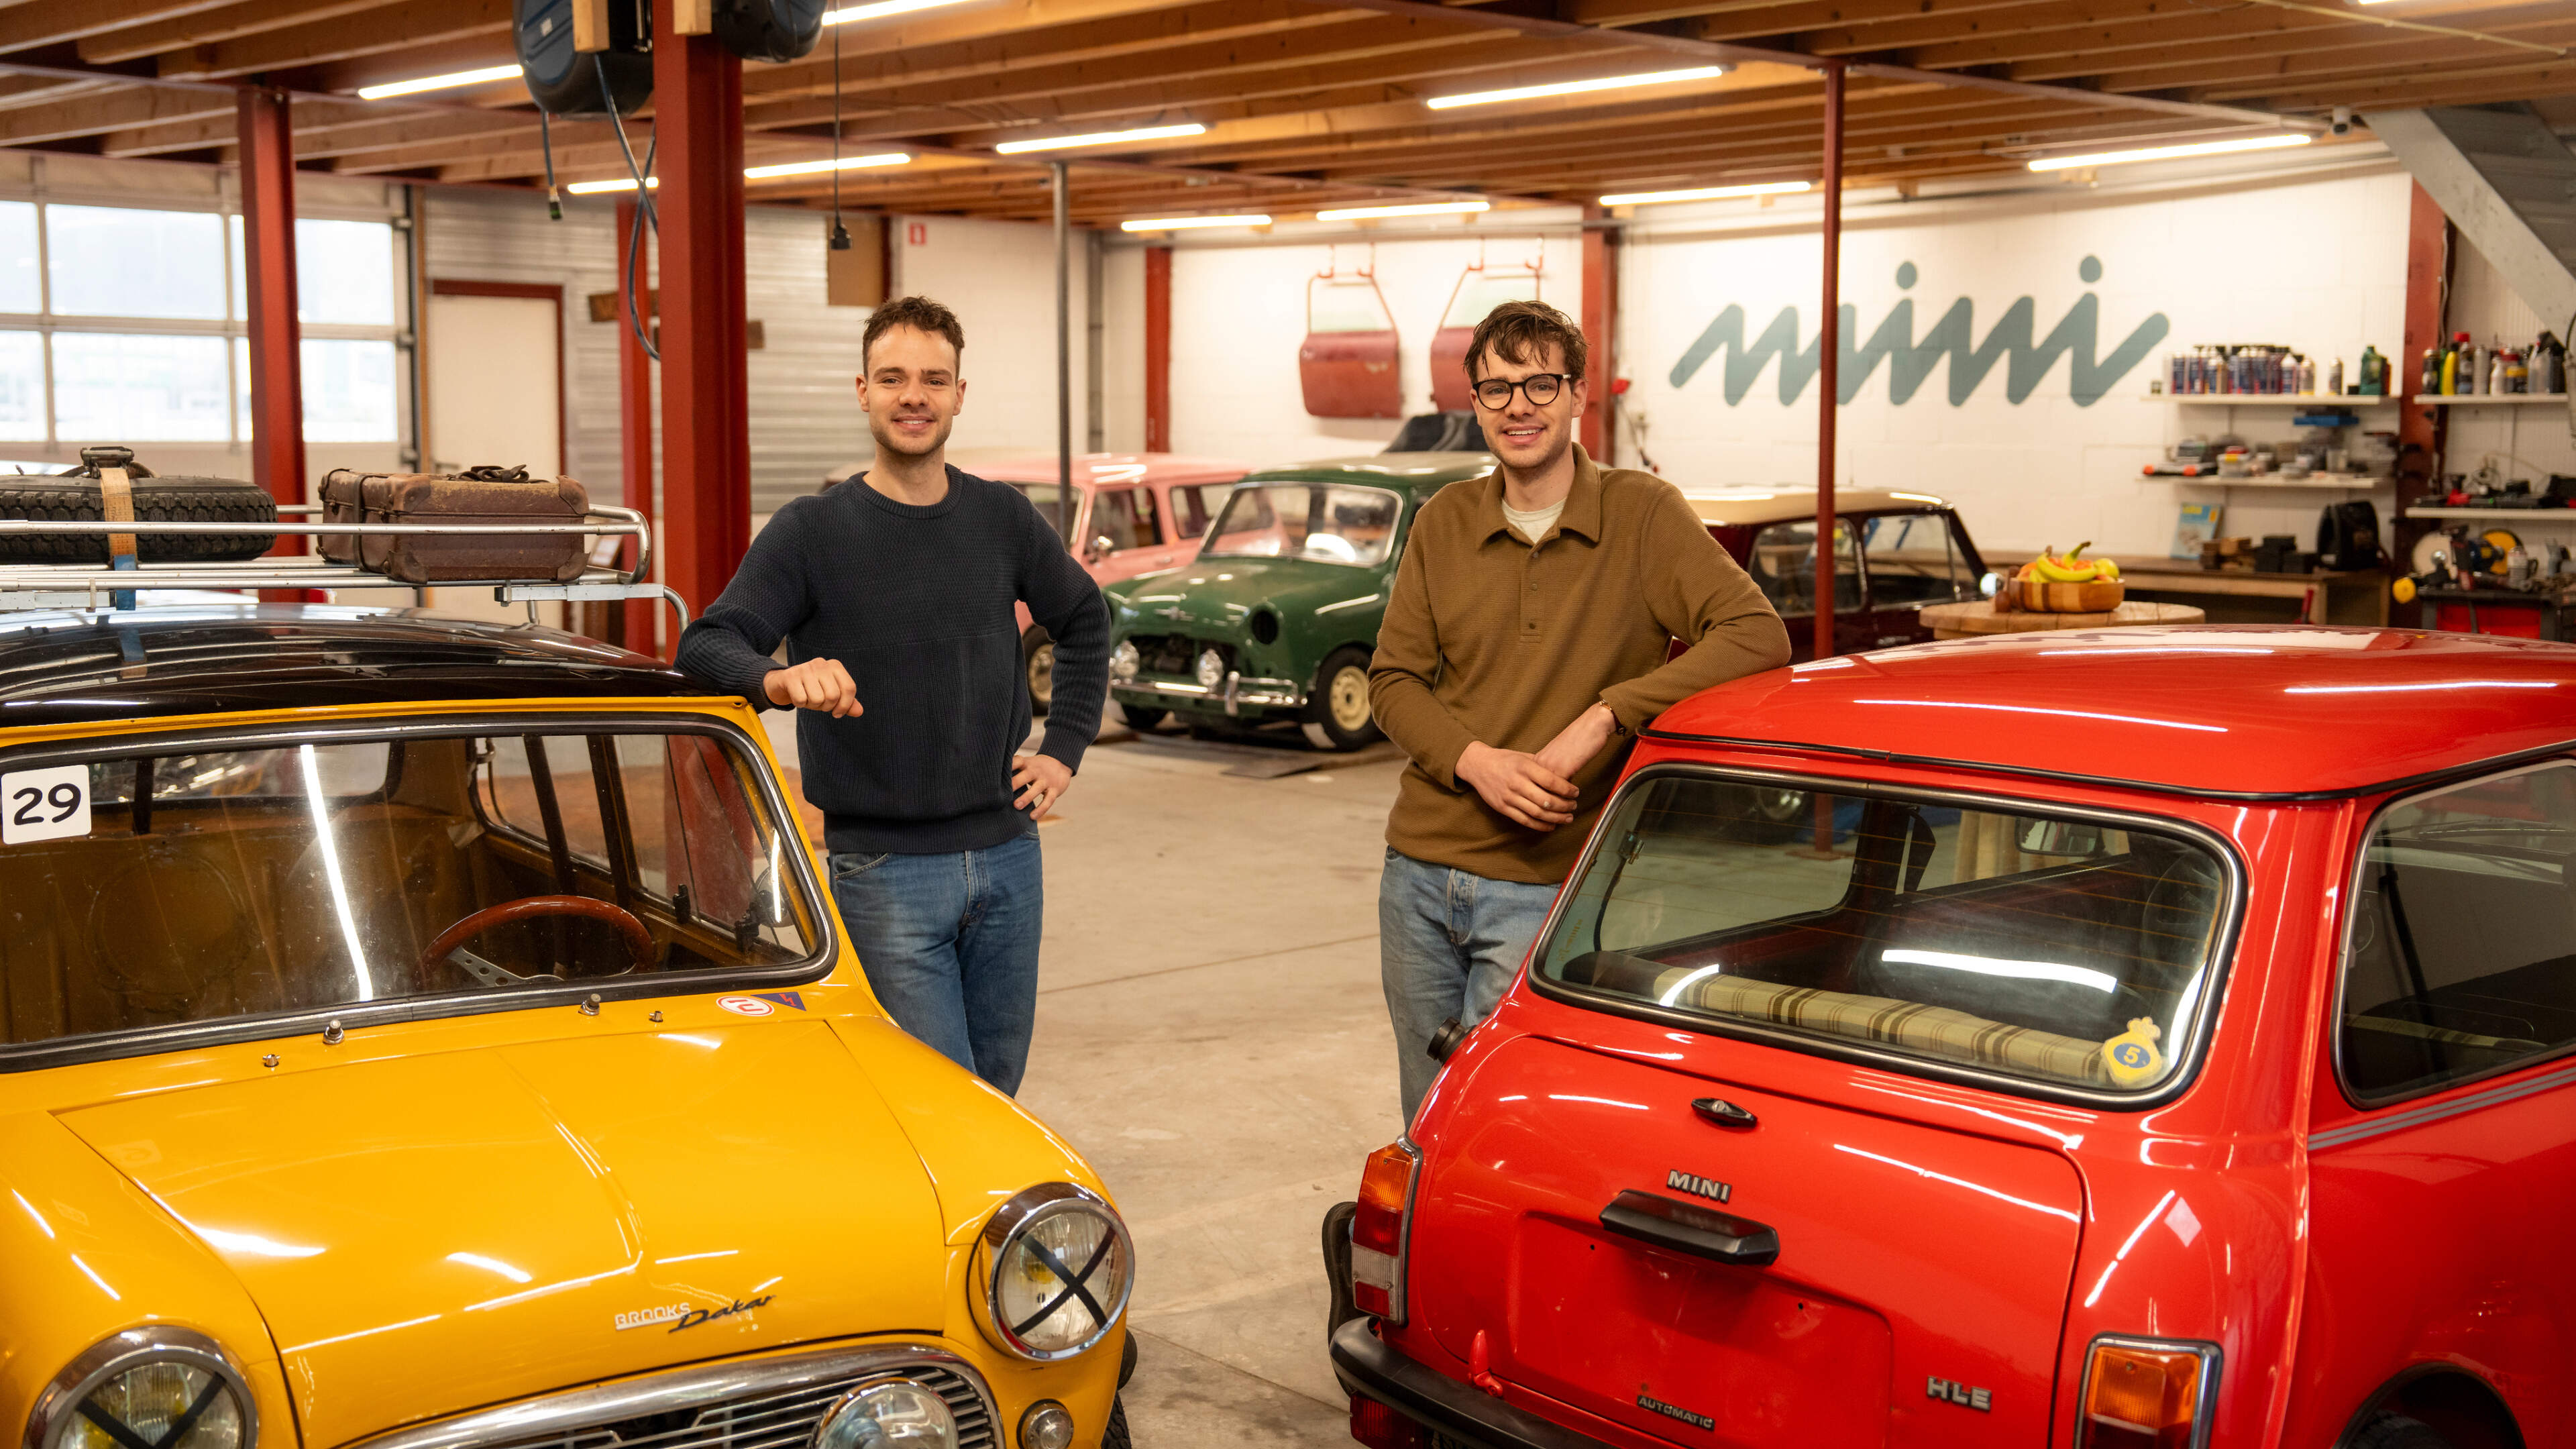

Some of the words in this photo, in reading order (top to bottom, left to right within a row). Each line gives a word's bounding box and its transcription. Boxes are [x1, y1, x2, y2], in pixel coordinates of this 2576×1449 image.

[13, 783, 81, 825] 29
[2123, 1046, 2141, 1064] 5
[1666, 1169, 1732, 1203] MINI
[614, 1302, 691, 1329] BROOKS
[668, 1295, 777, 1333] Dakar
[1927, 1375, 1991, 1412] HLE
[1638, 1396, 1714, 1430] AUTOMATIC
